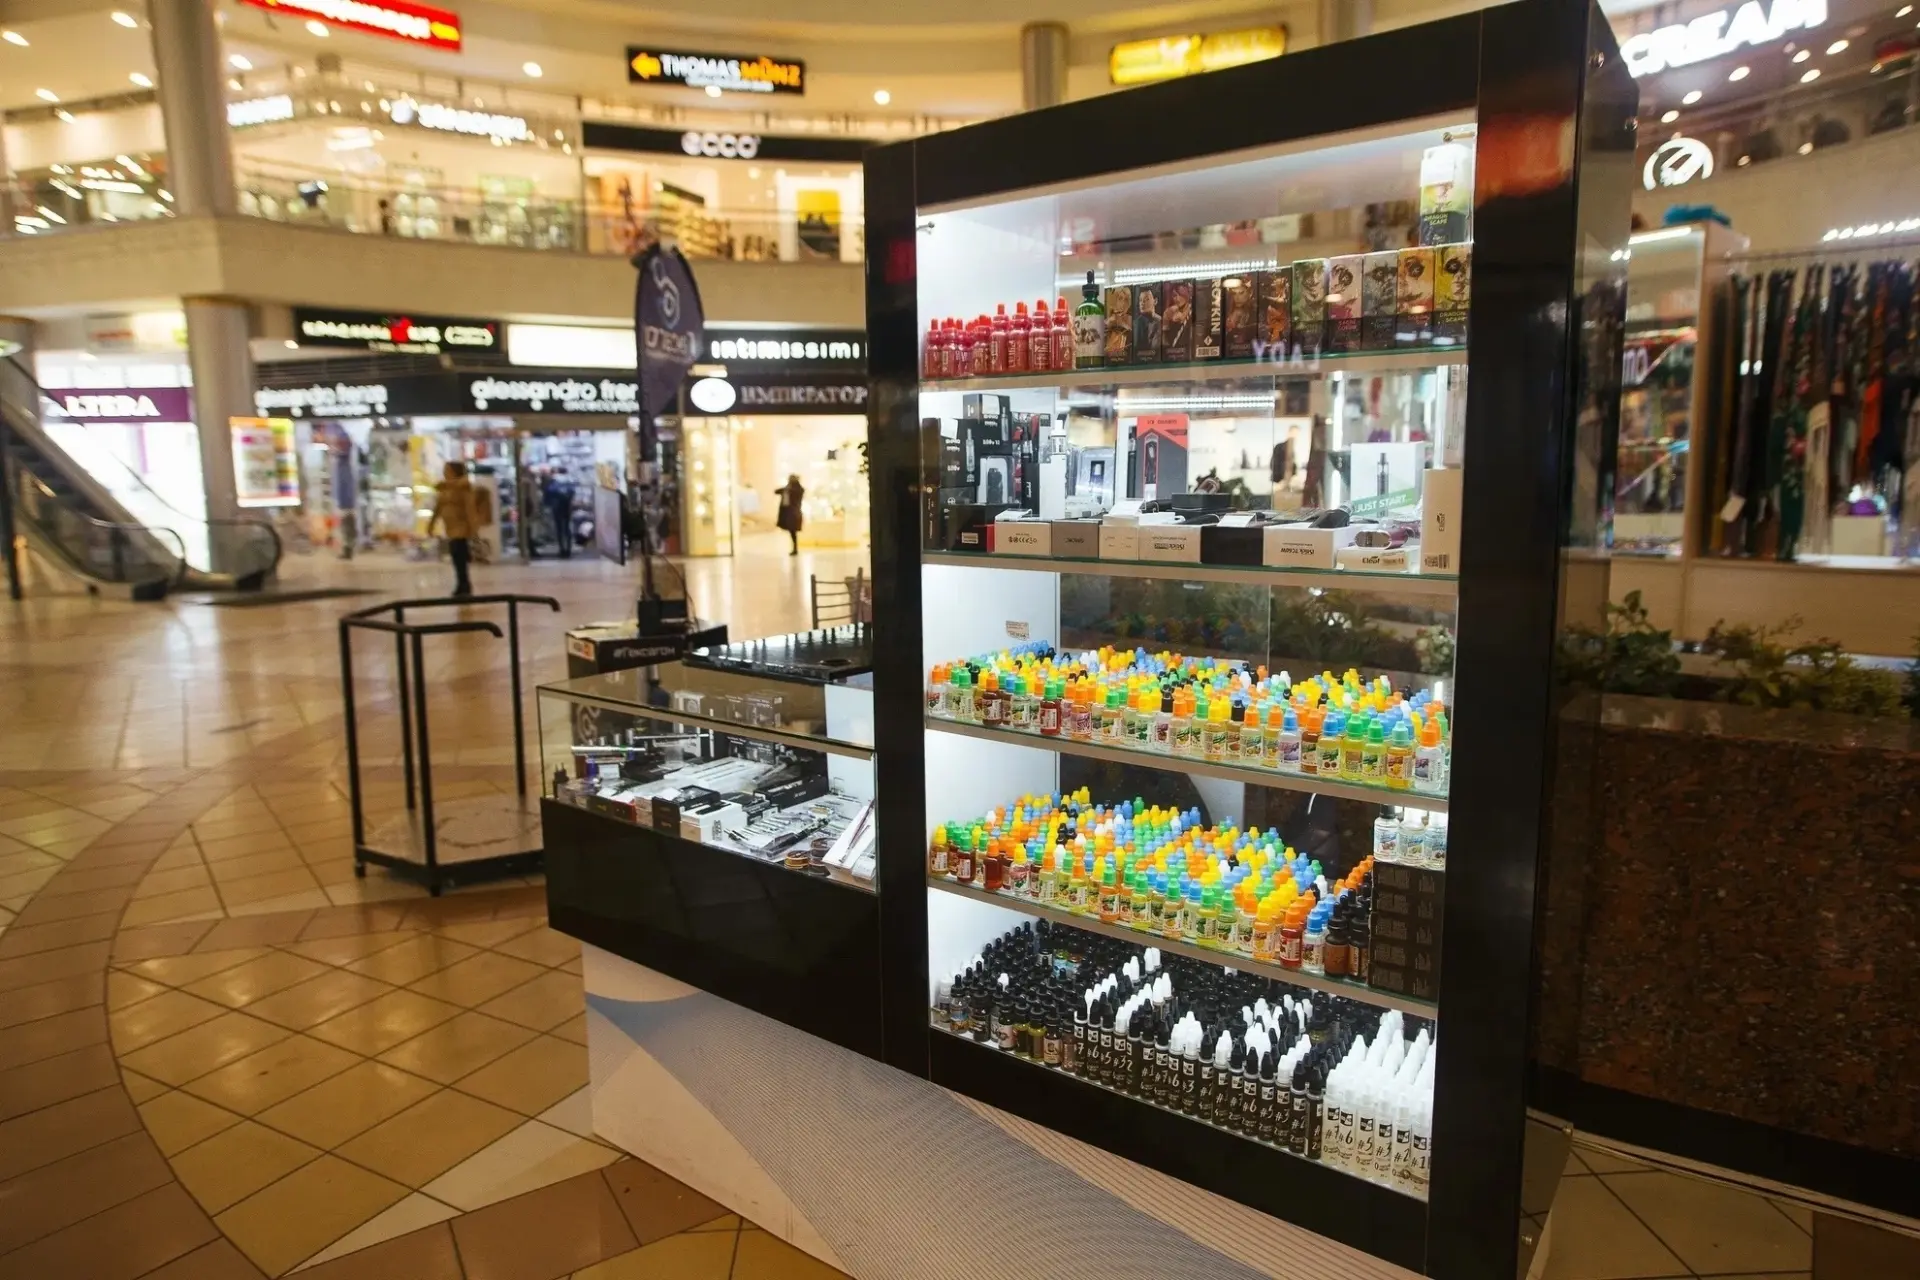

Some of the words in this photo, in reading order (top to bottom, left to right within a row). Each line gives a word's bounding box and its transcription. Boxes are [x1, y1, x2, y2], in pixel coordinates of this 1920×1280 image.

[1620, 0, 1830, 78] CREAM
[661, 54, 740, 80] THOMAS
[711, 338, 860, 359] intimissimi
[1355, 501, 1377, 512] JUST
[1243, 1098, 1257, 1112] #6
[1260, 1104, 1273, 1118] #5
[1275, 1109, 1290, 1123] #3
[1357, 1137, 1373, 1151] #5
[1376, 1141, 1392, 1157] #3
[1394, 1148, 1411, 1162] #2
[1411, 1156, 1426, 1169] #1
